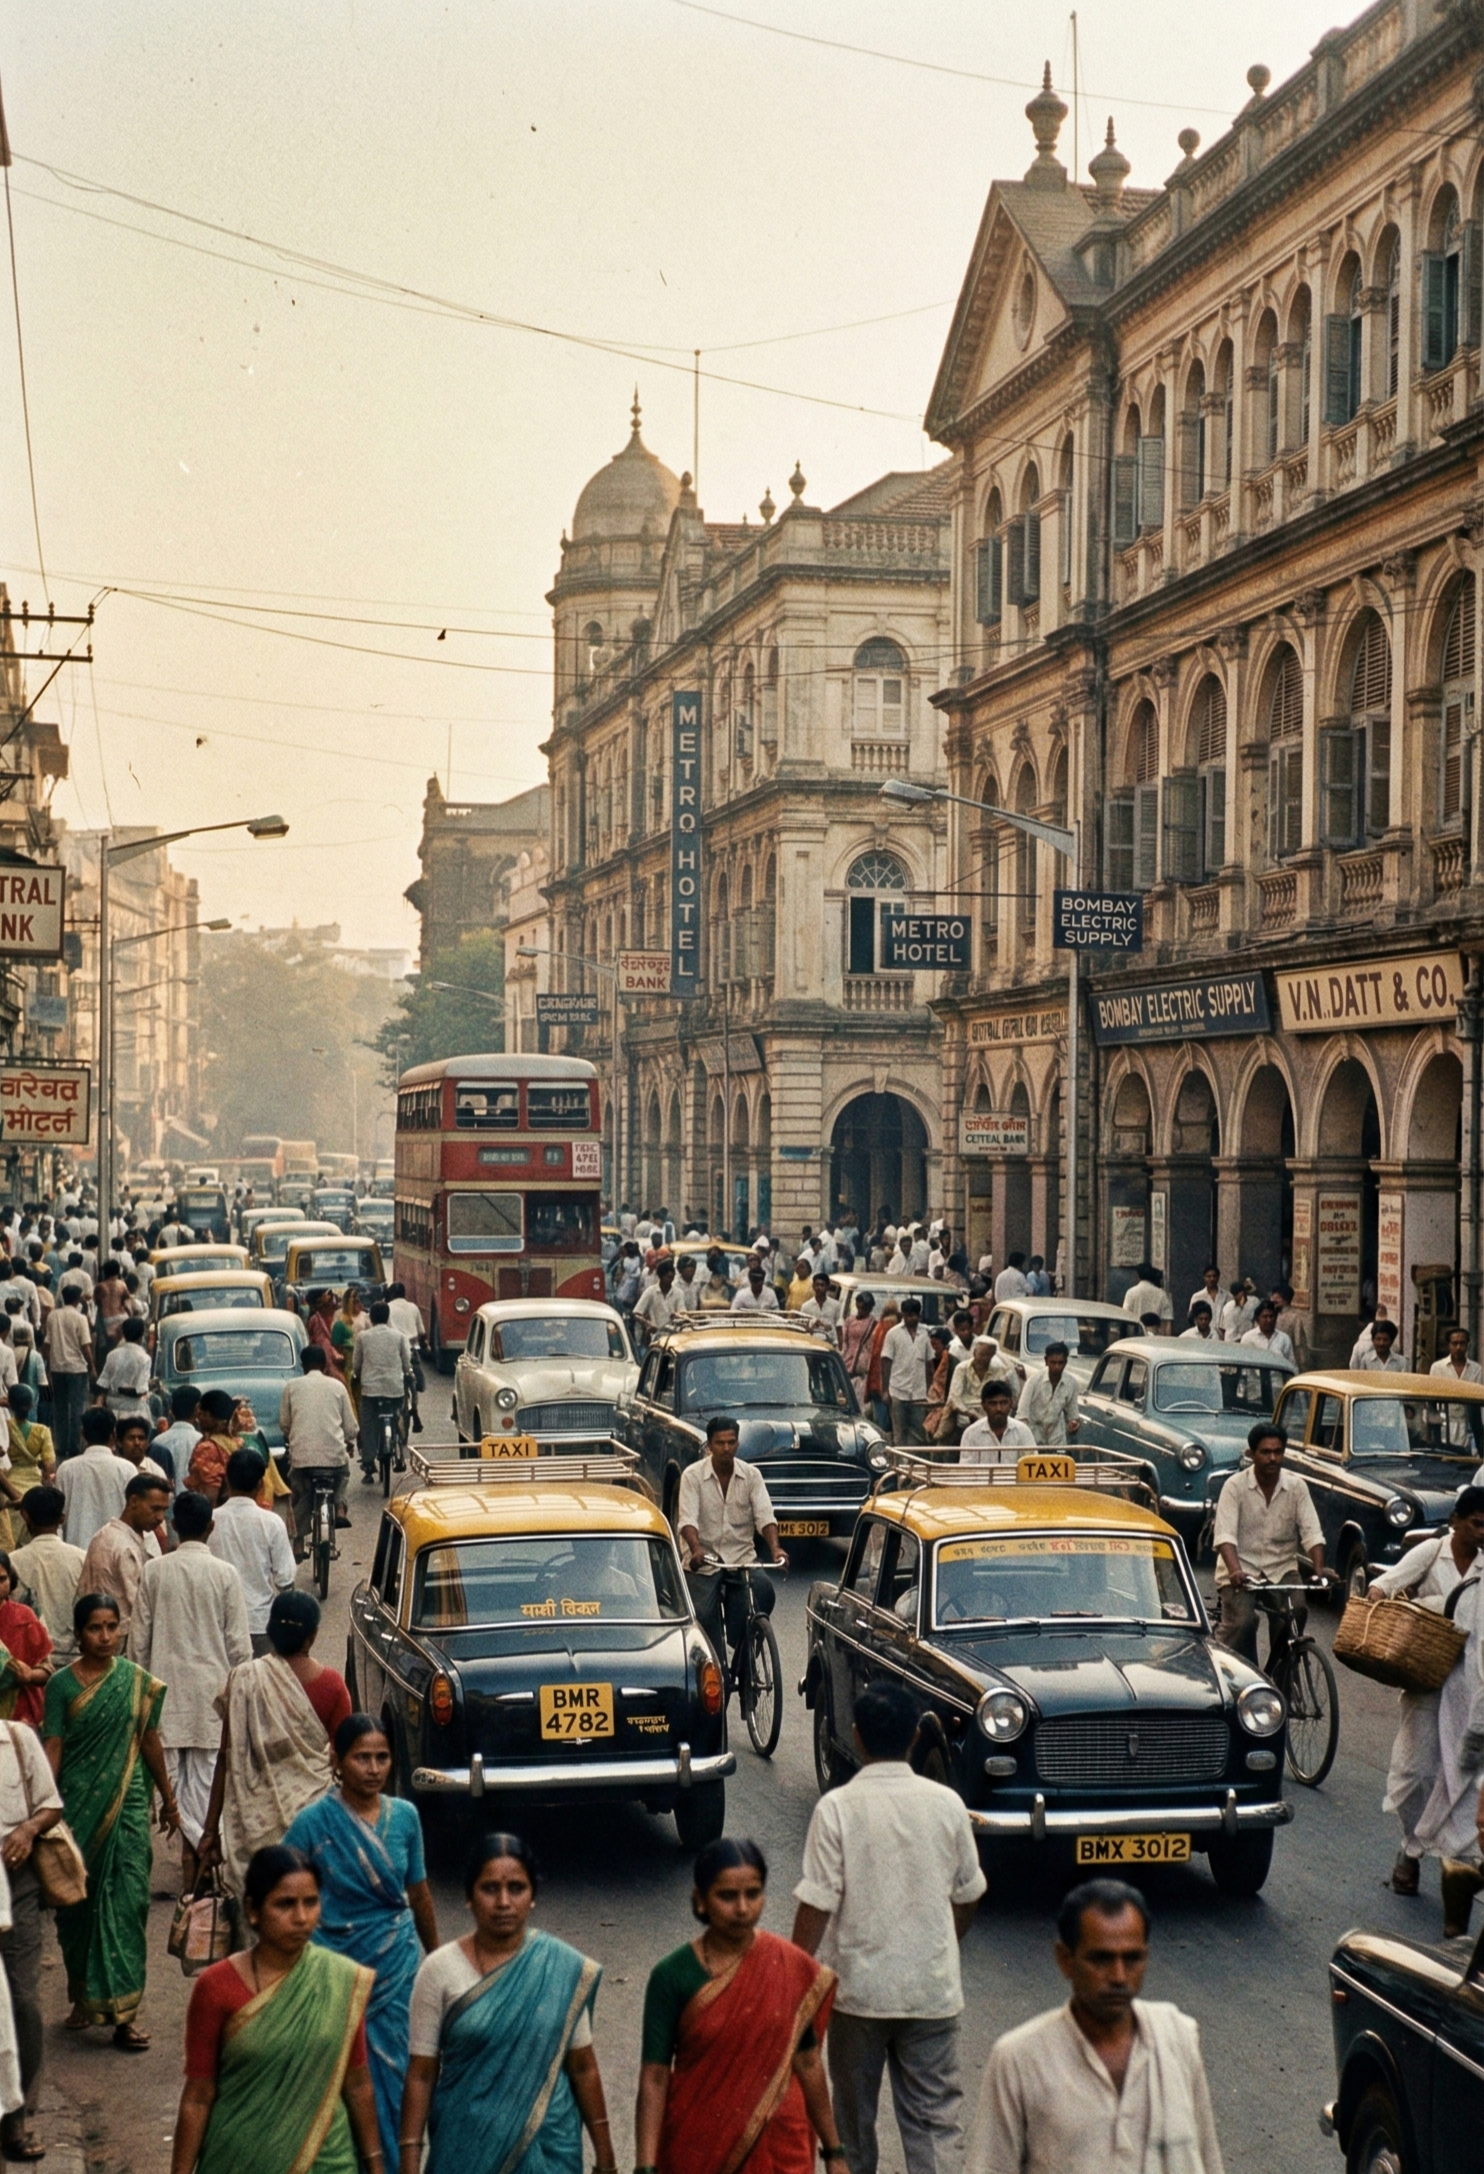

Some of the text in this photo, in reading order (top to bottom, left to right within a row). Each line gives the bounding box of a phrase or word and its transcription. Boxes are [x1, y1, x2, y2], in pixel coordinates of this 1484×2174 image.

[678, 705, 698, 977] METRO HOTEL
[1061, 897, 1137, 915] BOMBAY
[891, 920, 965, 939] METRO
[1061, 914, 1137, 931] ELECTRIC
[1064, 930, 1133, 946] SUPPLY
[894, 944, 962, 962] HOTEL
[625, 976, 667, 989] BANK
[1392, 971, 1410, 1012] &
[1416, 963, 1456, 1010] CO.
[1098, 995, 1143, 1029] BOMBAY
[1147, 988, 1205, 1024] ELECTRIC
[1208, 981, 1255, 1018] SUPPLY
[488, 1443, 529, 1457] TAXI
[1023, 1462, 1069, 1478] TAXI
[553, 1688, 600, 1709] BMR
[546, 1711, 609, 1734] 4782
[1080, 1838, 1187, 1860] BMX 3012
